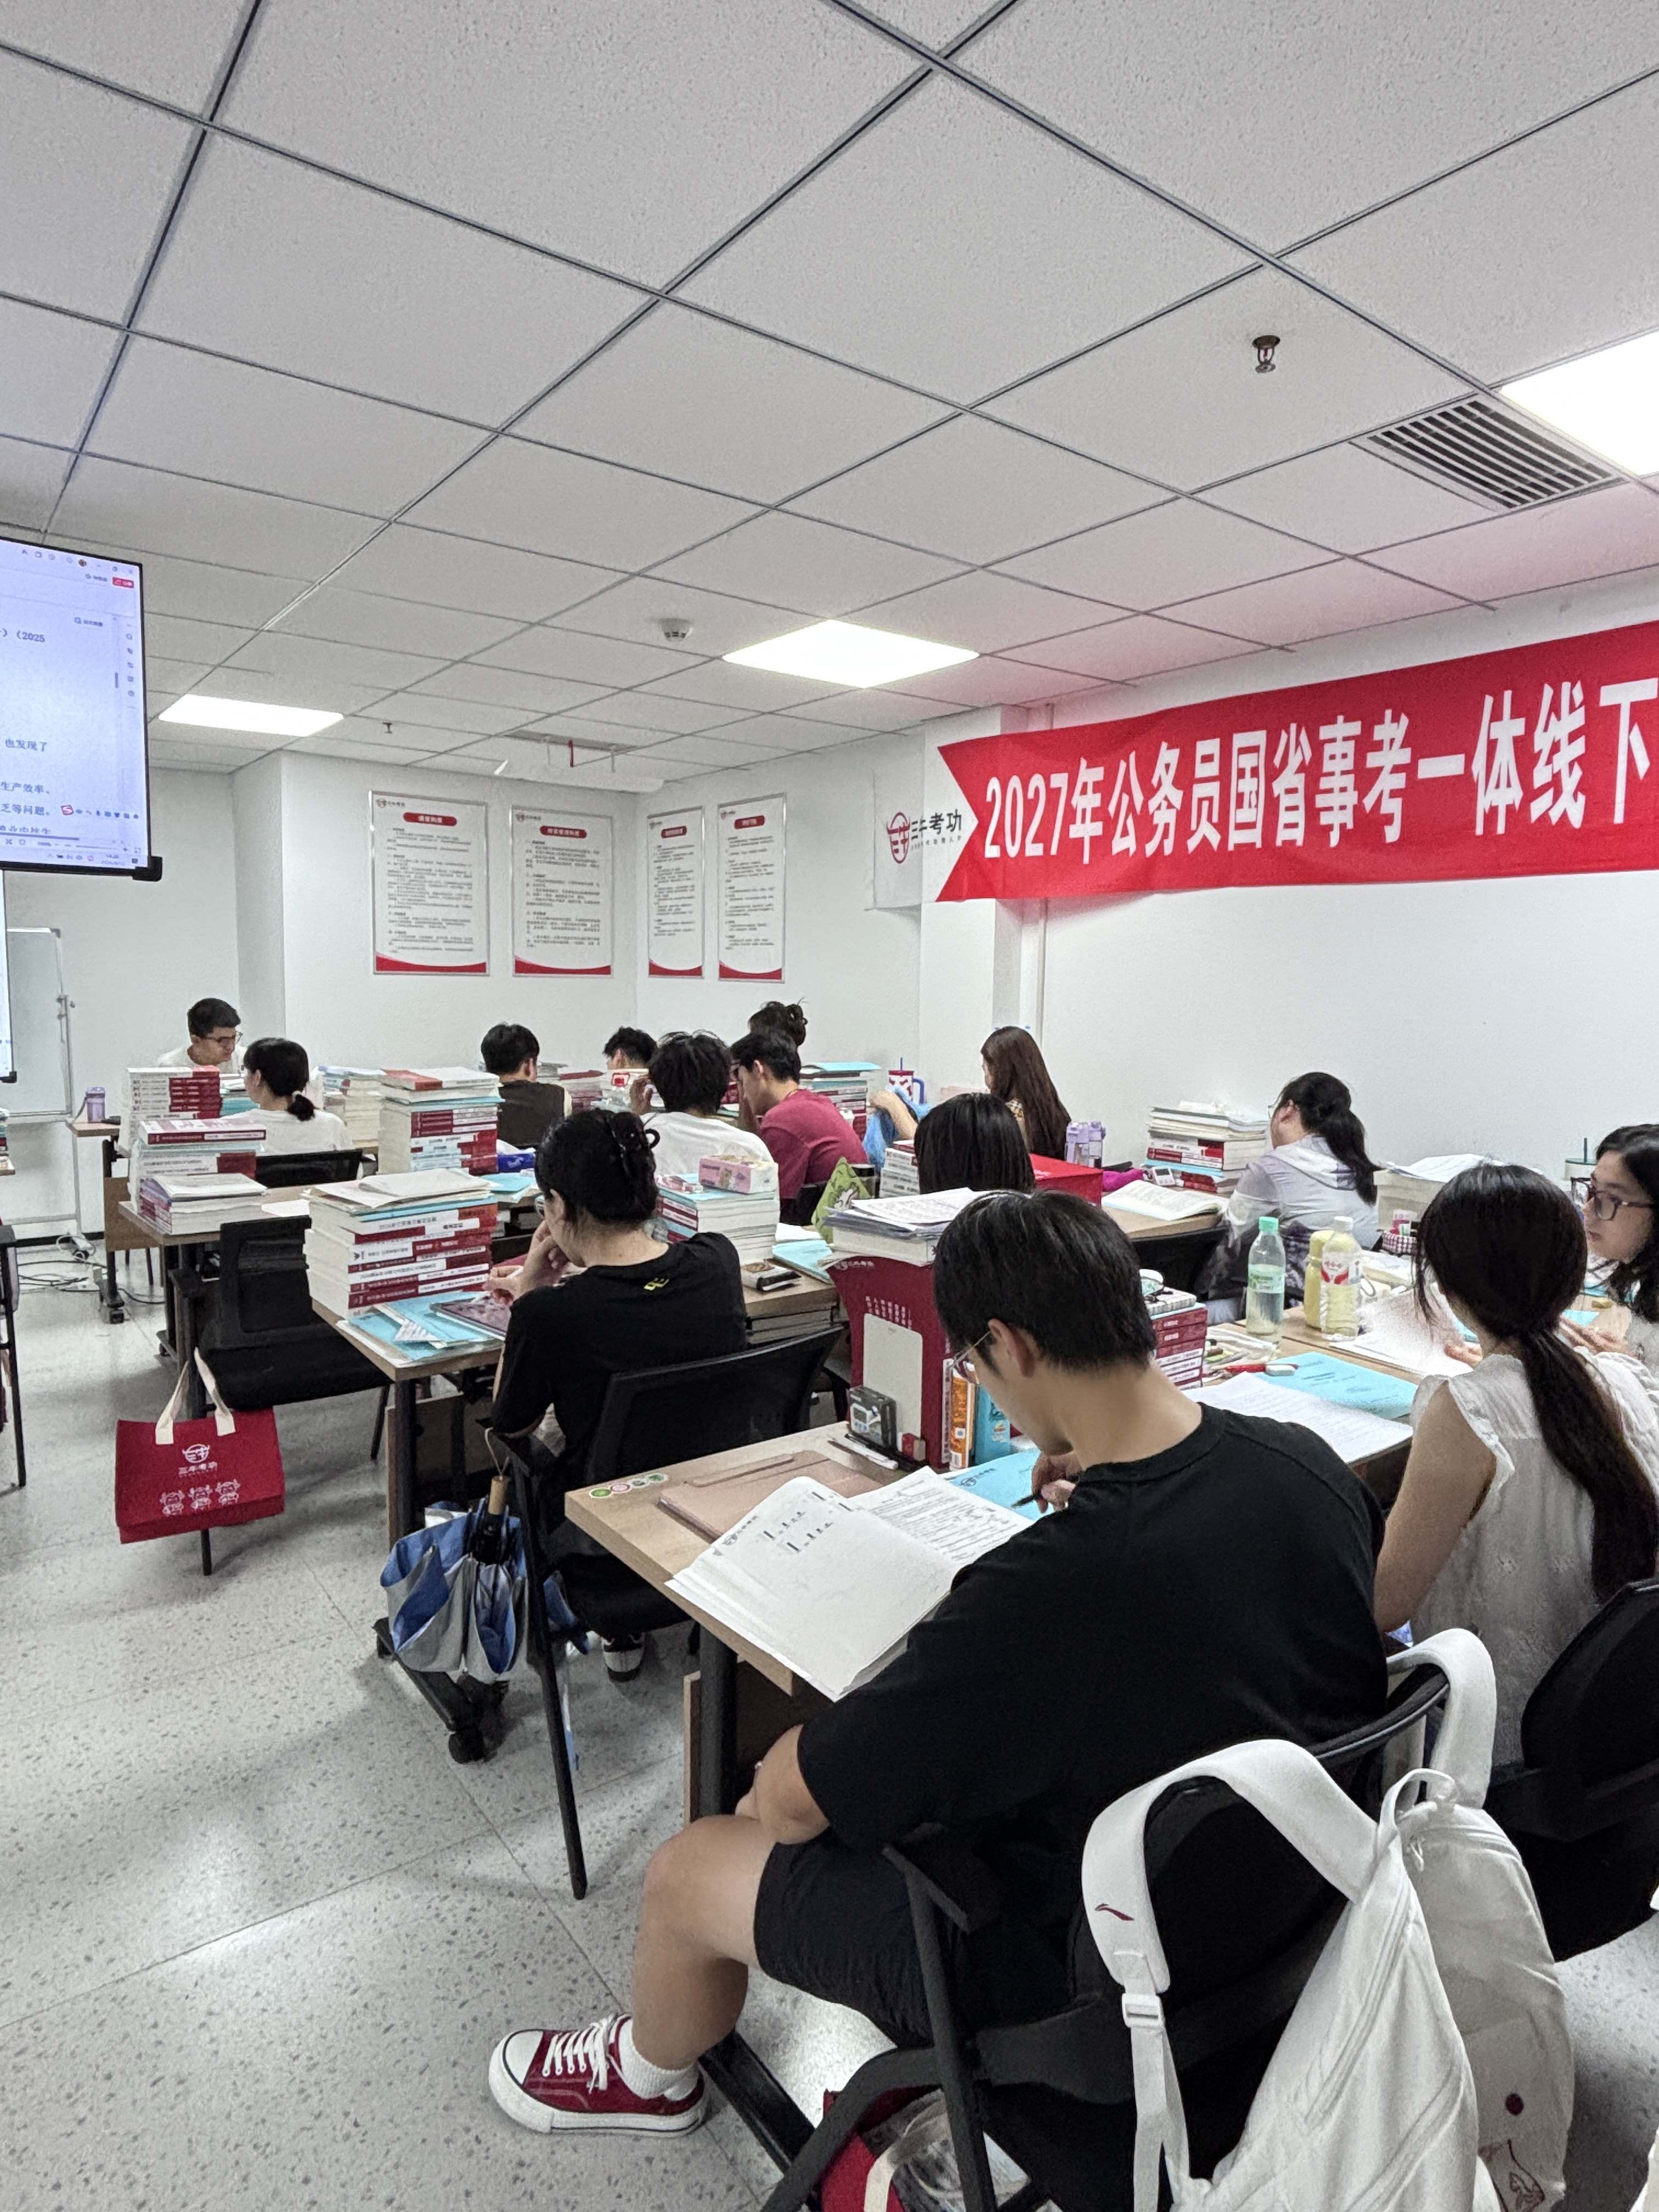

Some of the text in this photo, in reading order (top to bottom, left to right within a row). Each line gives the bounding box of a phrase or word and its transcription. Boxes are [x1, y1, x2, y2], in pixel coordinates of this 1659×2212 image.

[5, 738, 47, 752] 也发现了
[984, 678, 1658, 865] 2027年公务员国省事考一体线下
